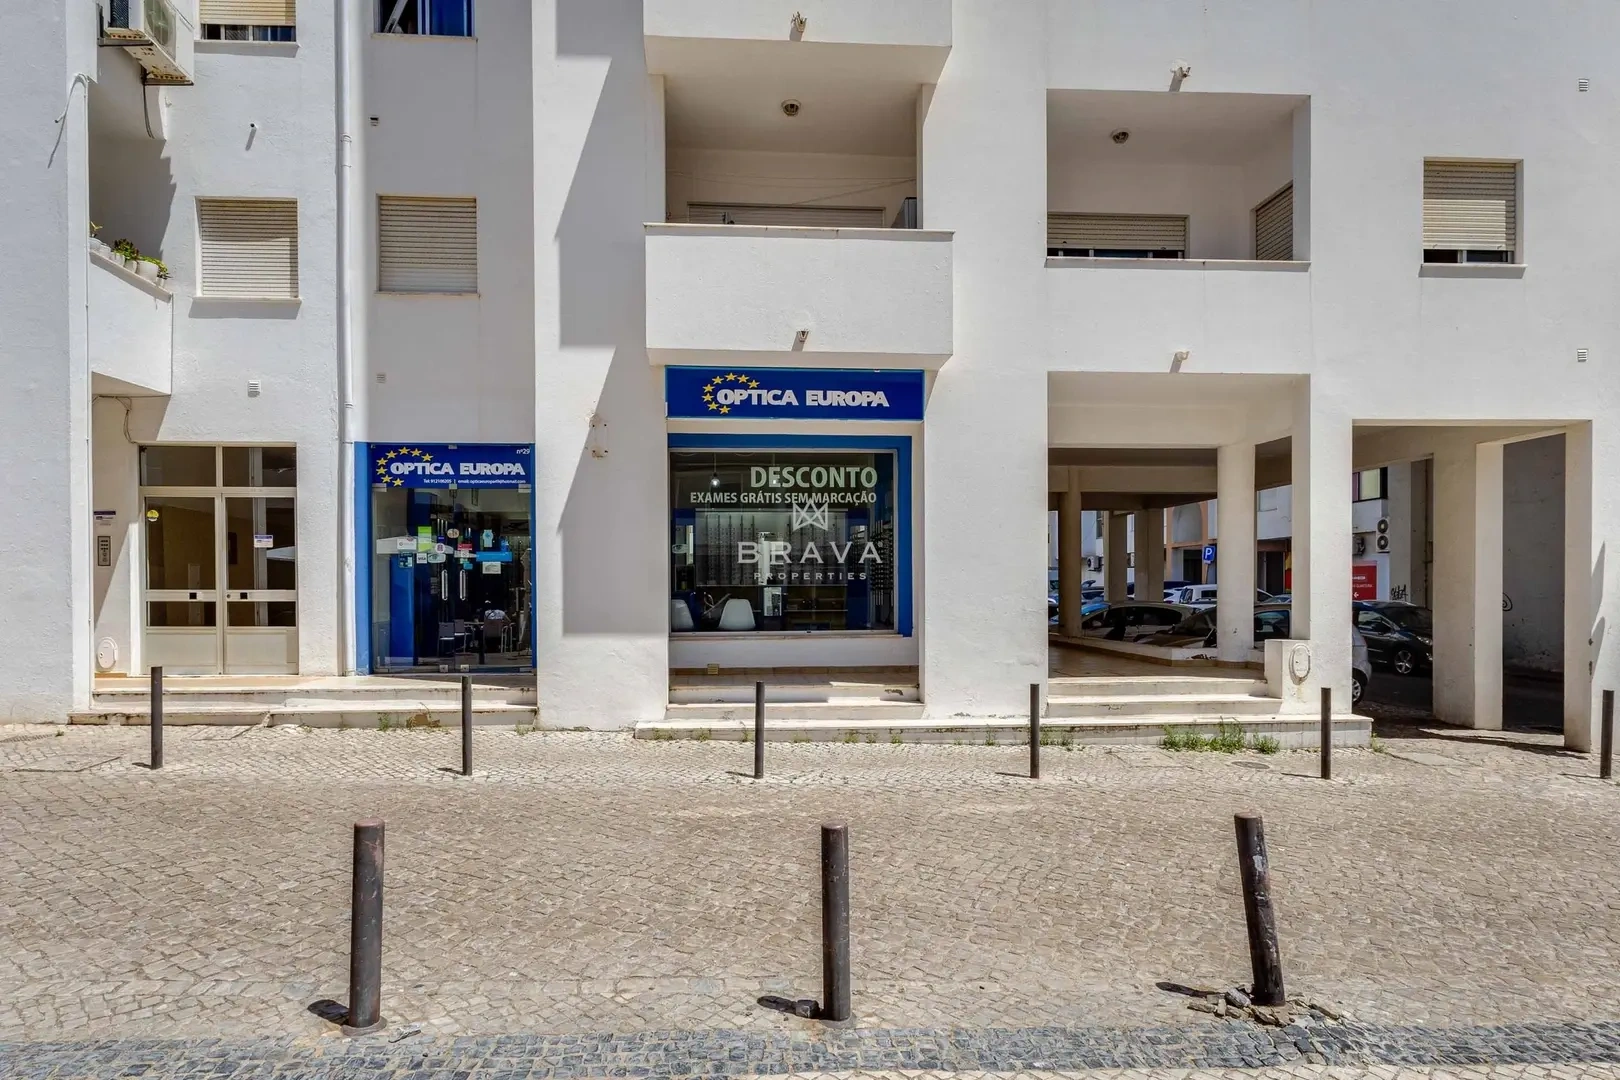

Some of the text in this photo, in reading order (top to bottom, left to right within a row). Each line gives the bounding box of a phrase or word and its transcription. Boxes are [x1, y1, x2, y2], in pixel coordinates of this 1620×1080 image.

[716, 389, 890, 407] OPTICA EUROPA
[390, 462, 526, 476] OPTICA EUROPA
[750, 466, 878, 489] DESCONTO
[690, 490, 877, 507] EXAMES GRÁTIS SEM MARCAÇÃO
[1205, 547, 1213, 560] P
